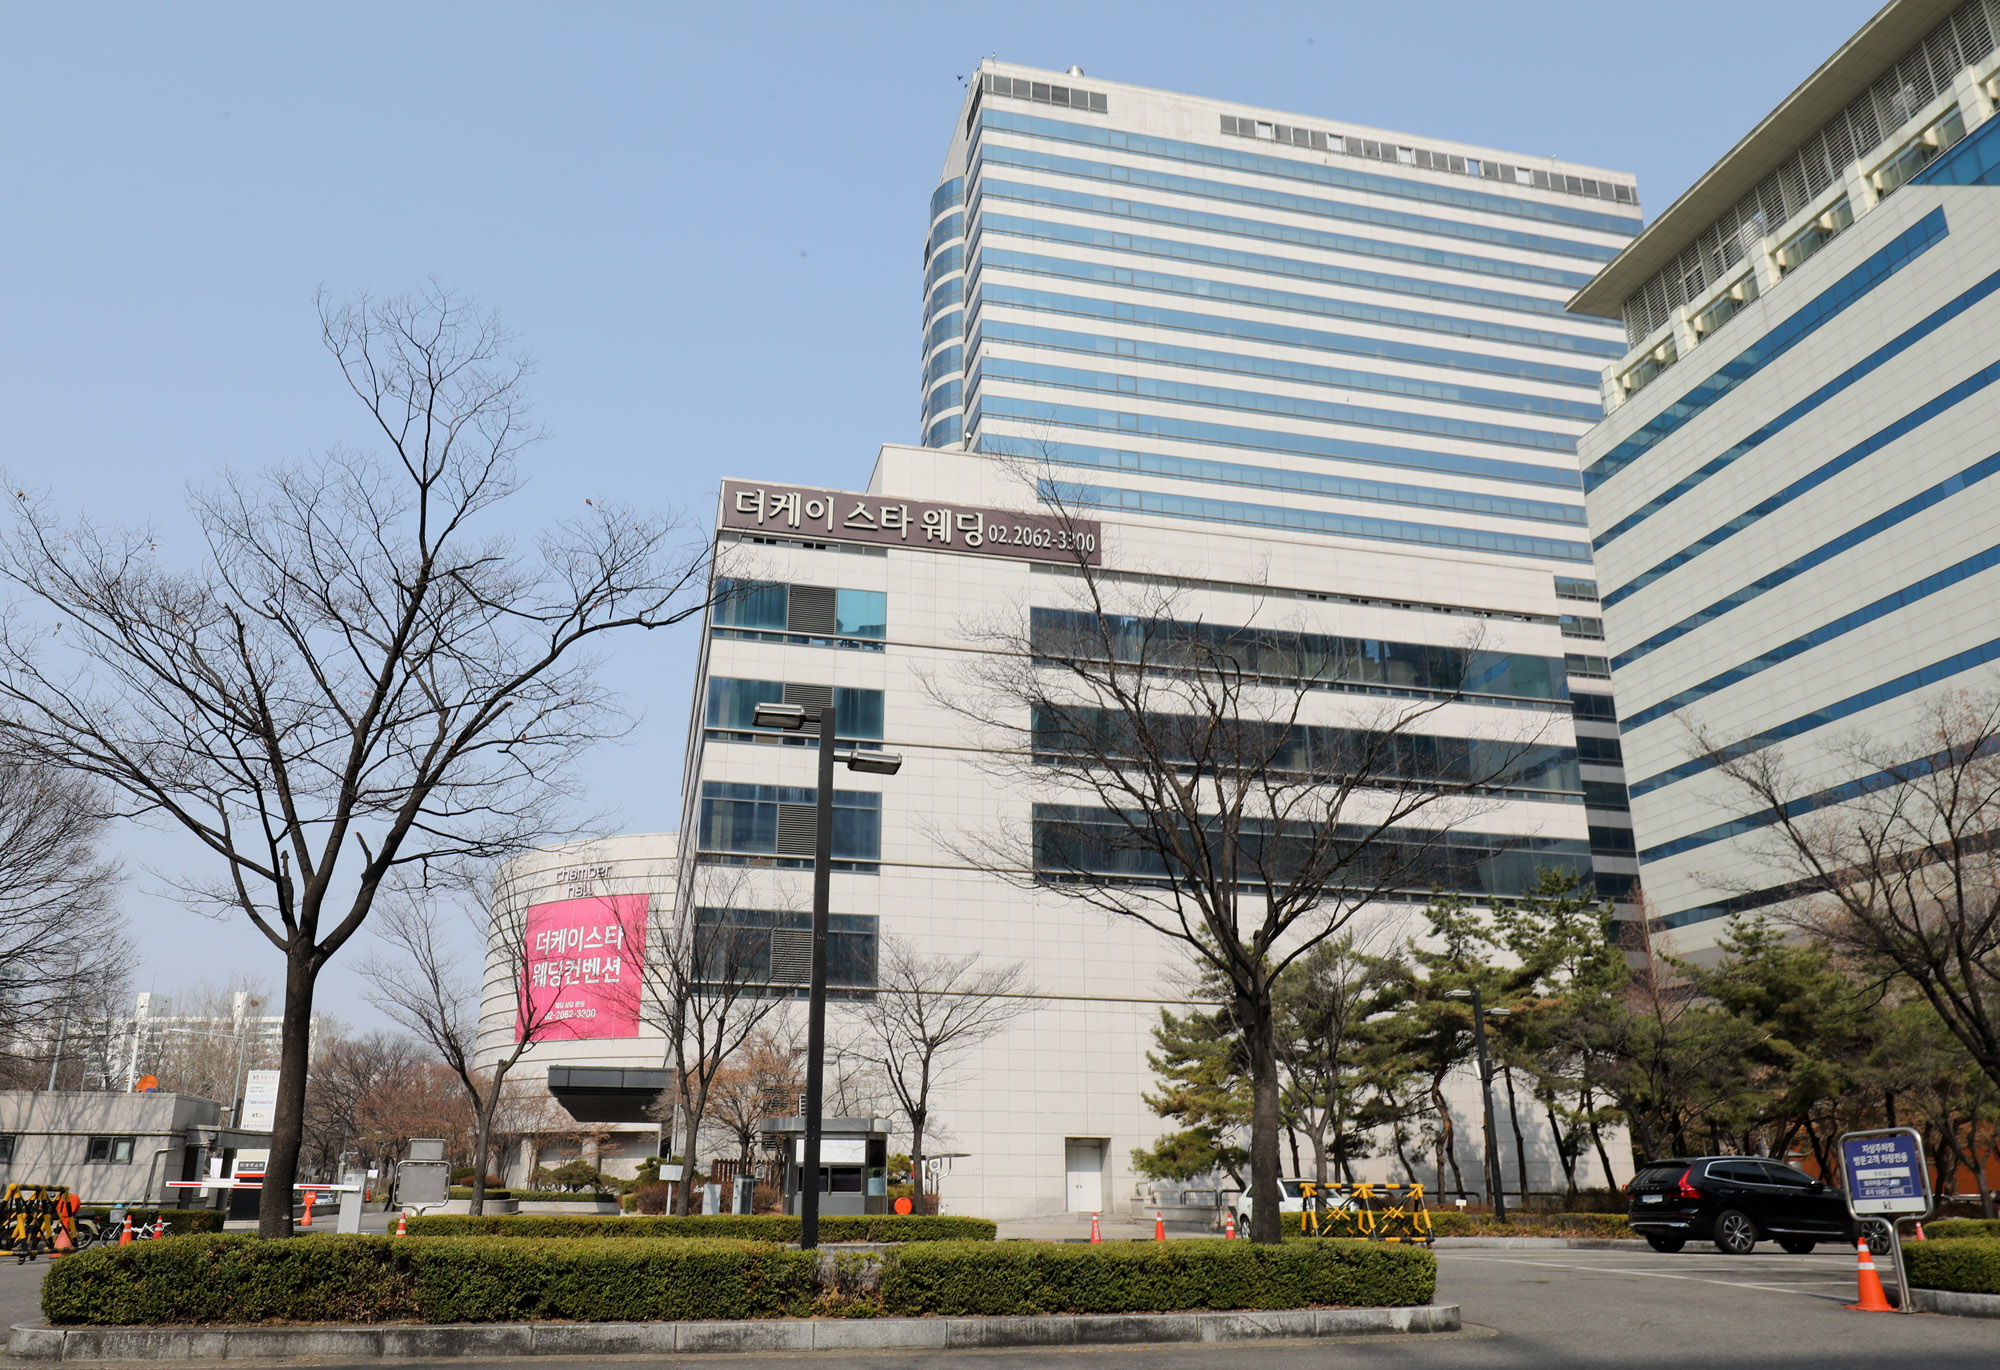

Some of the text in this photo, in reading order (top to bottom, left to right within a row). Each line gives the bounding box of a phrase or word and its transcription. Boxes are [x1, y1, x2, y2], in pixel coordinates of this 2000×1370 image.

[921, 508, 984, 547] 웨딩
[556, 863, 613, 883] chamber
[567, 880, 594, 898] hall
[536, 925, 624, 956] 더케이스타
[532, 955, 622, 988] 웨딩컨벤션
[1861, 1142, 1895, 1154] 지상주차장
